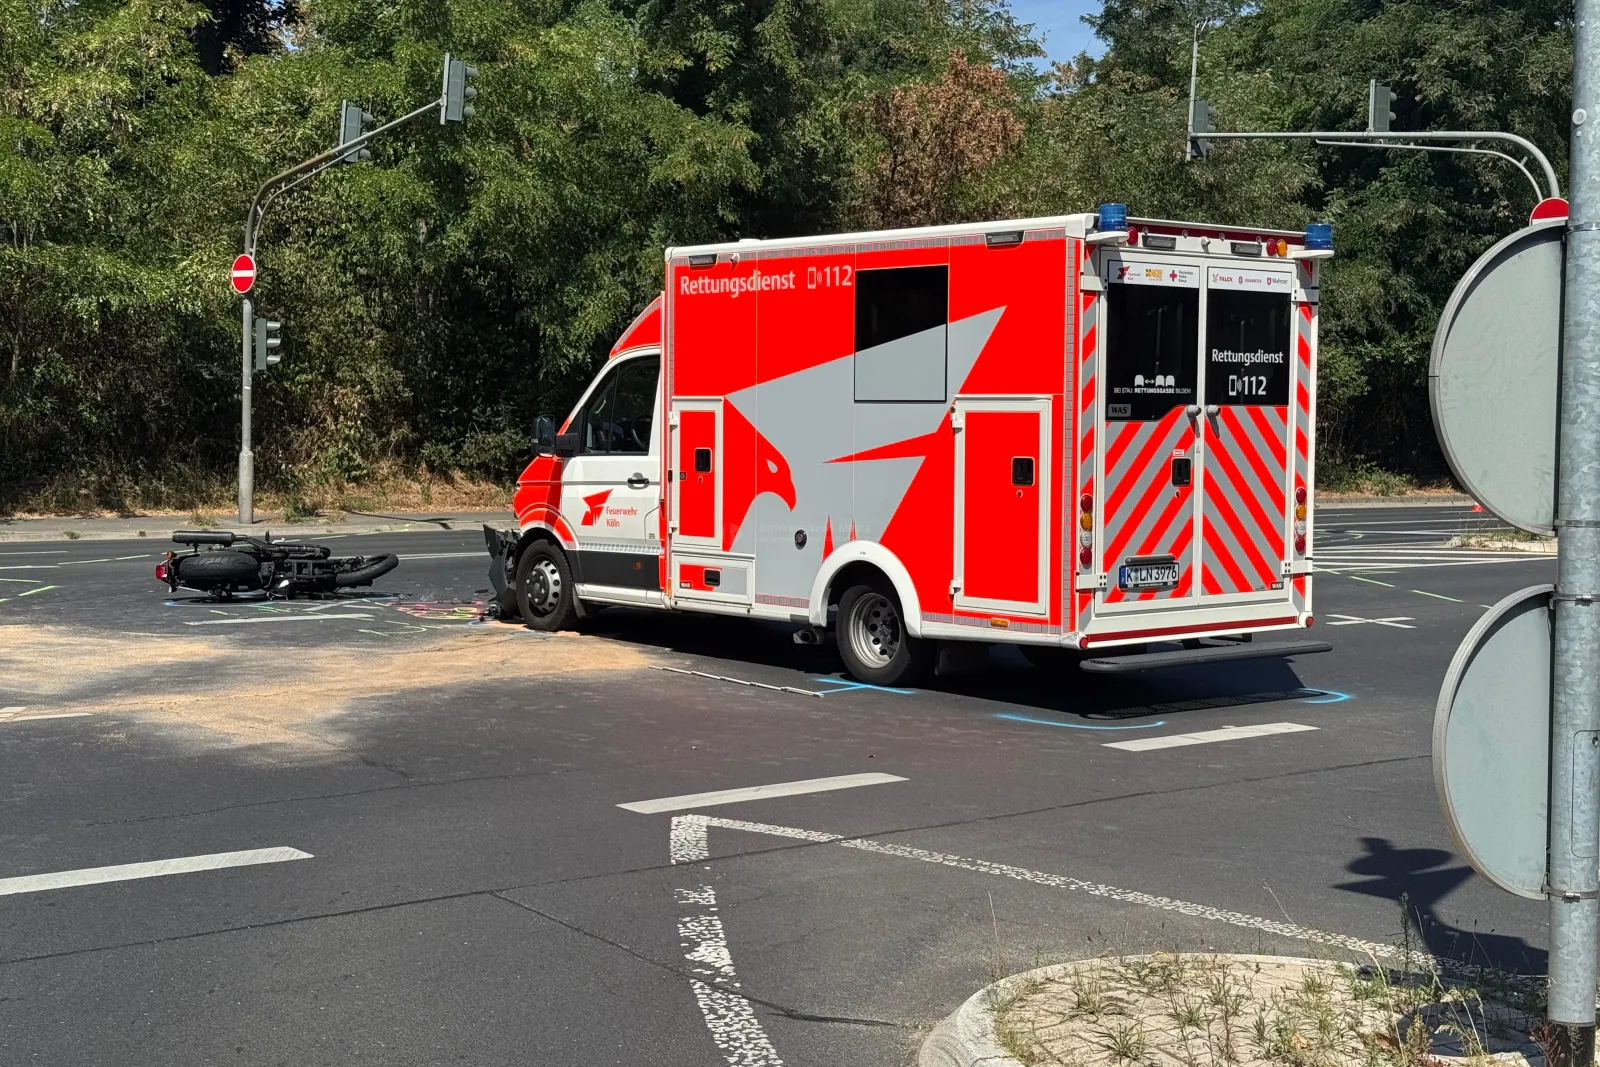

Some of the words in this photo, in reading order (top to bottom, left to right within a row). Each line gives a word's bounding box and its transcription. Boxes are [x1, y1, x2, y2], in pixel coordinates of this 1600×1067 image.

[680, 269, 796, 298] Rettungsdienst
[823, 265, 853, 287] 112
[1212, 348, 1283, 366] Rettungsdienst
[1242, 375, 1267, 395] 112
[1111, 406, 1128, 414] WAS
[606, 506, 638, 516] Feuerwehr
[606, 518, 621, 527] Köln
[1126, 566, 1133, 583] K
[1139, 566, 1153, 582] LN
[1154, 565, 1177, 581] 3976
